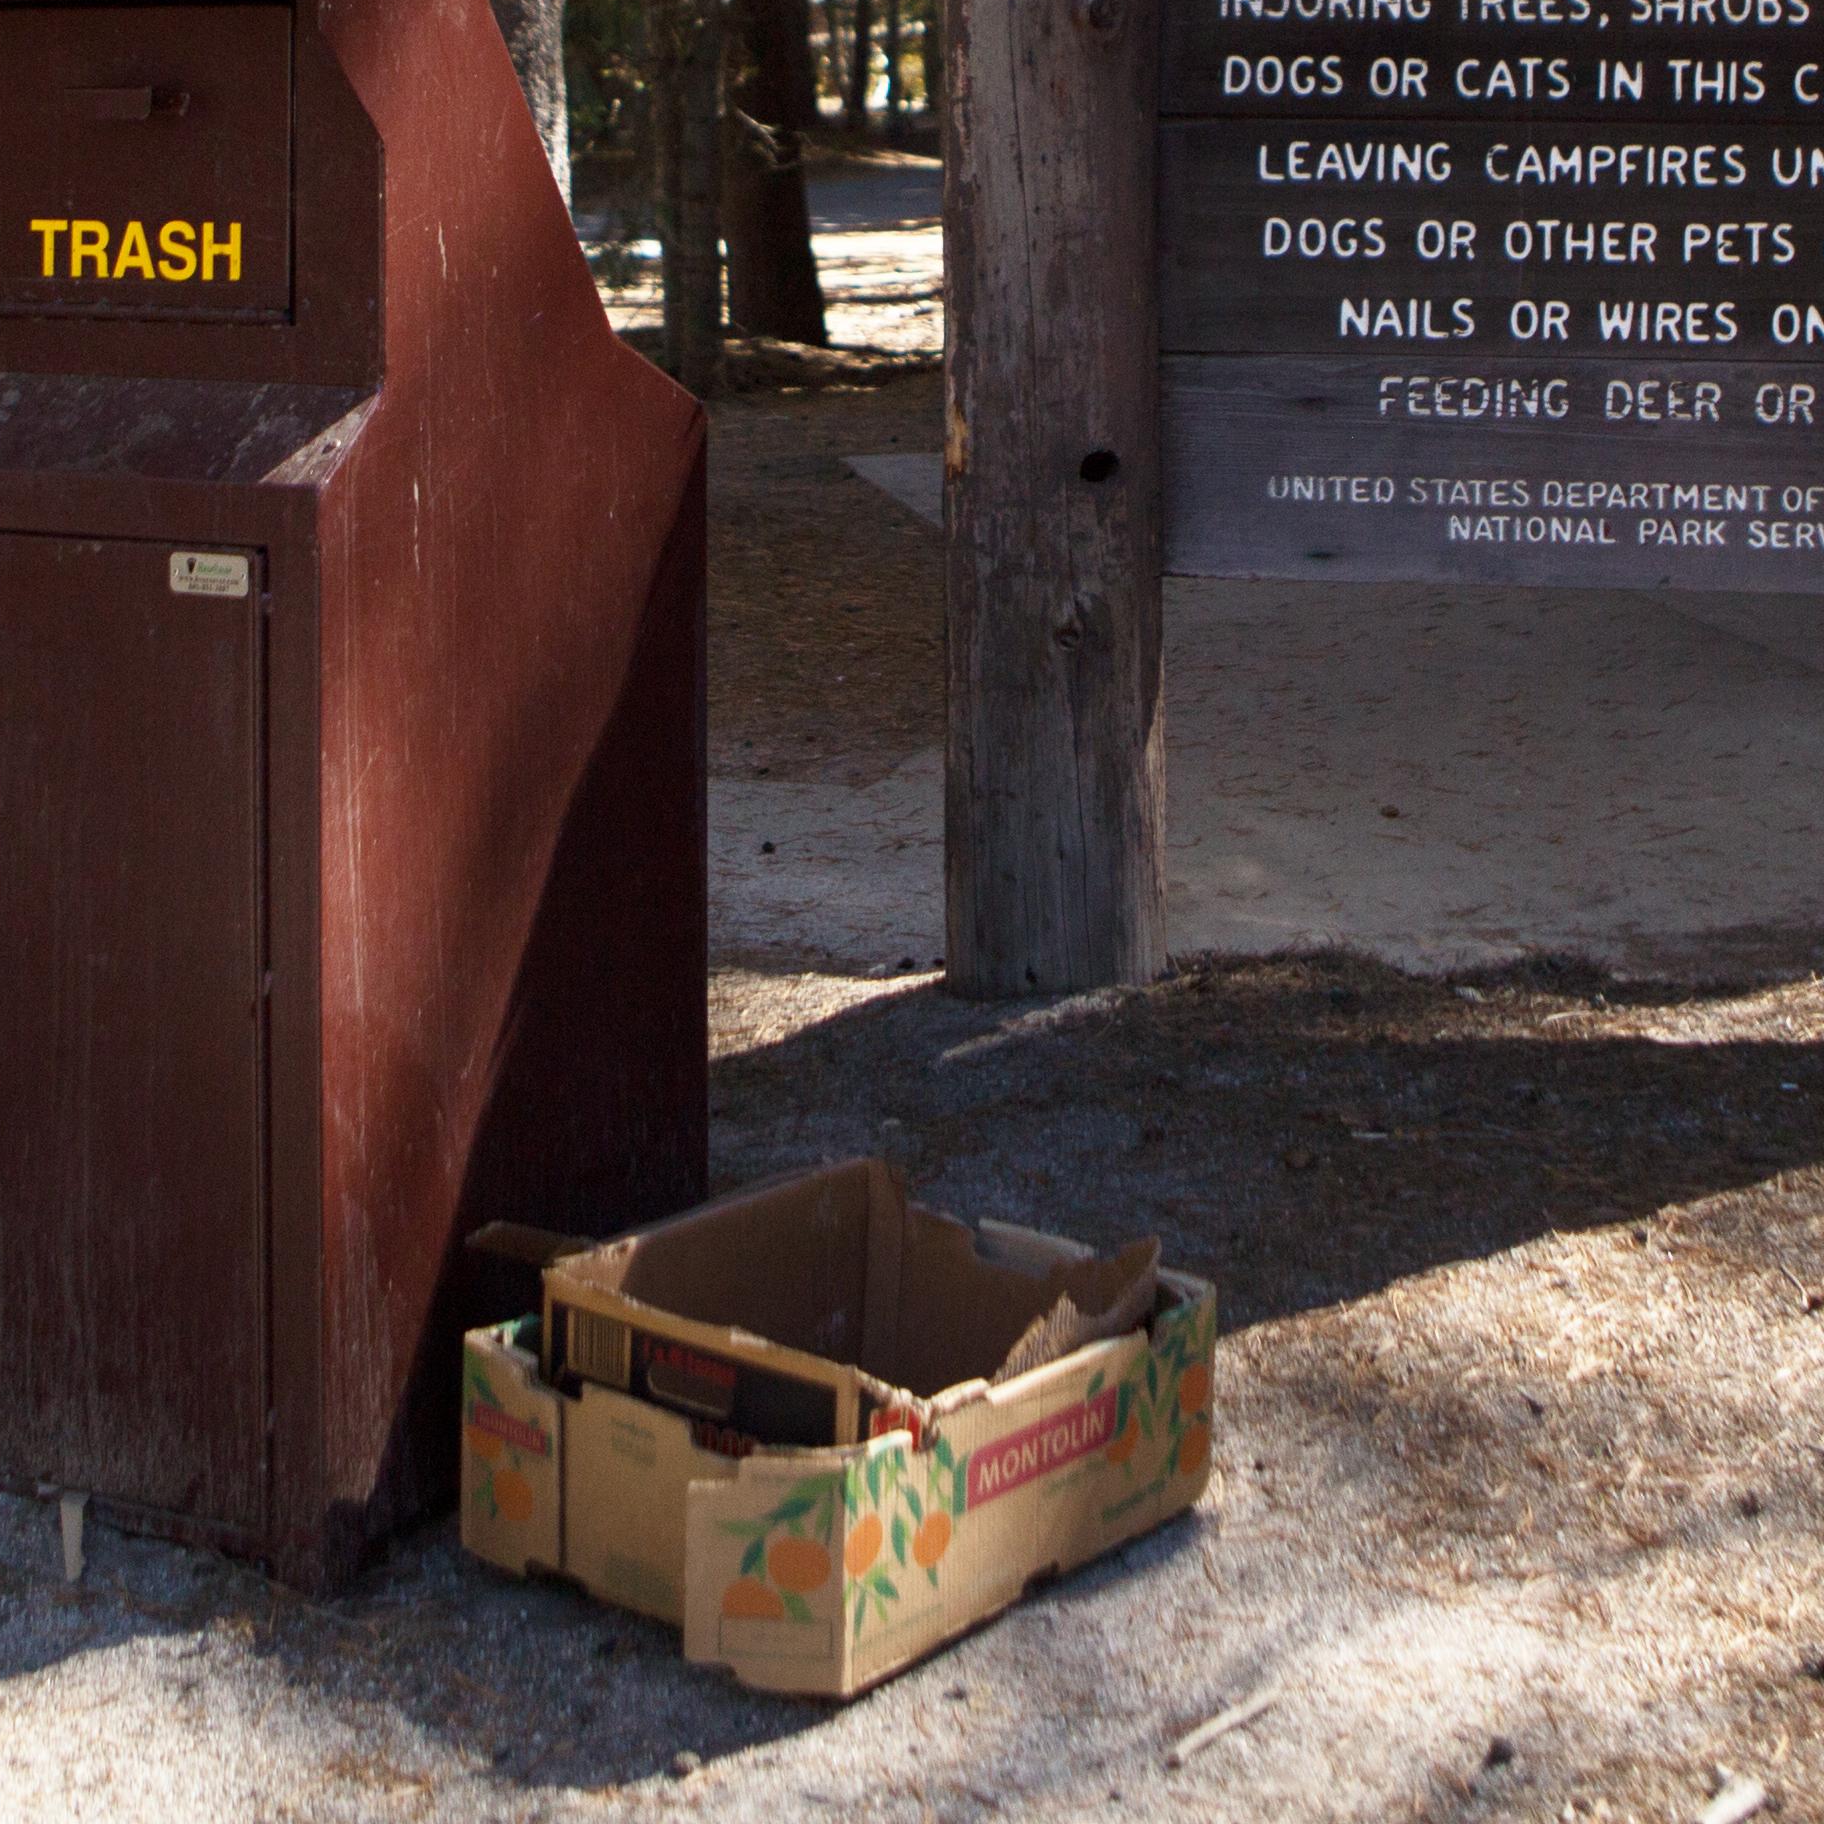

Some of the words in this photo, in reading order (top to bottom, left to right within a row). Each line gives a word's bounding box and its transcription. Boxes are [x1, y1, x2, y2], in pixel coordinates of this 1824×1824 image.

[1224, 56, 1343, 96] DOGS
[1370, 58, 1428, 97] OR
[1456, 58, 1569, 99] CATS
[1599, 61, 1642, 99] IN
[1669, 60, 1765, 102] THIS
[1260, 142, 1451, 182] LEAVING
[1486, 144, 1746, 186] CAMPFIRES
[31, 220, 241, 280] TRASH
[1264, 217, 1385, 258] DOGS
[1417, 220, 1476, 259] OR
[1505, 220, 1657, 262] OTHER
[1684, 223, 1795, 263] PETS
[1340, 299, 1474, 339] NAILS
[1511, 301, 1569, 339] OR
[1600, 302, 1737, 343] WIRES
[1380, 377, 1568, 418] FEEDING
[1605, 380, 1721, 420] DEER
[1756, 383, 1815, 423] OR
[1269, 477, 1395, 503] UNITED
[1410, 479, 1530, 507] STATES
[1543, 481, 1769, 511] DEPARTMENT
[1782, 486, 1824, 512] OF
[1449, 516, 1615, 544] NATIONAL
[1639, 519, 1725, 545] PARK
